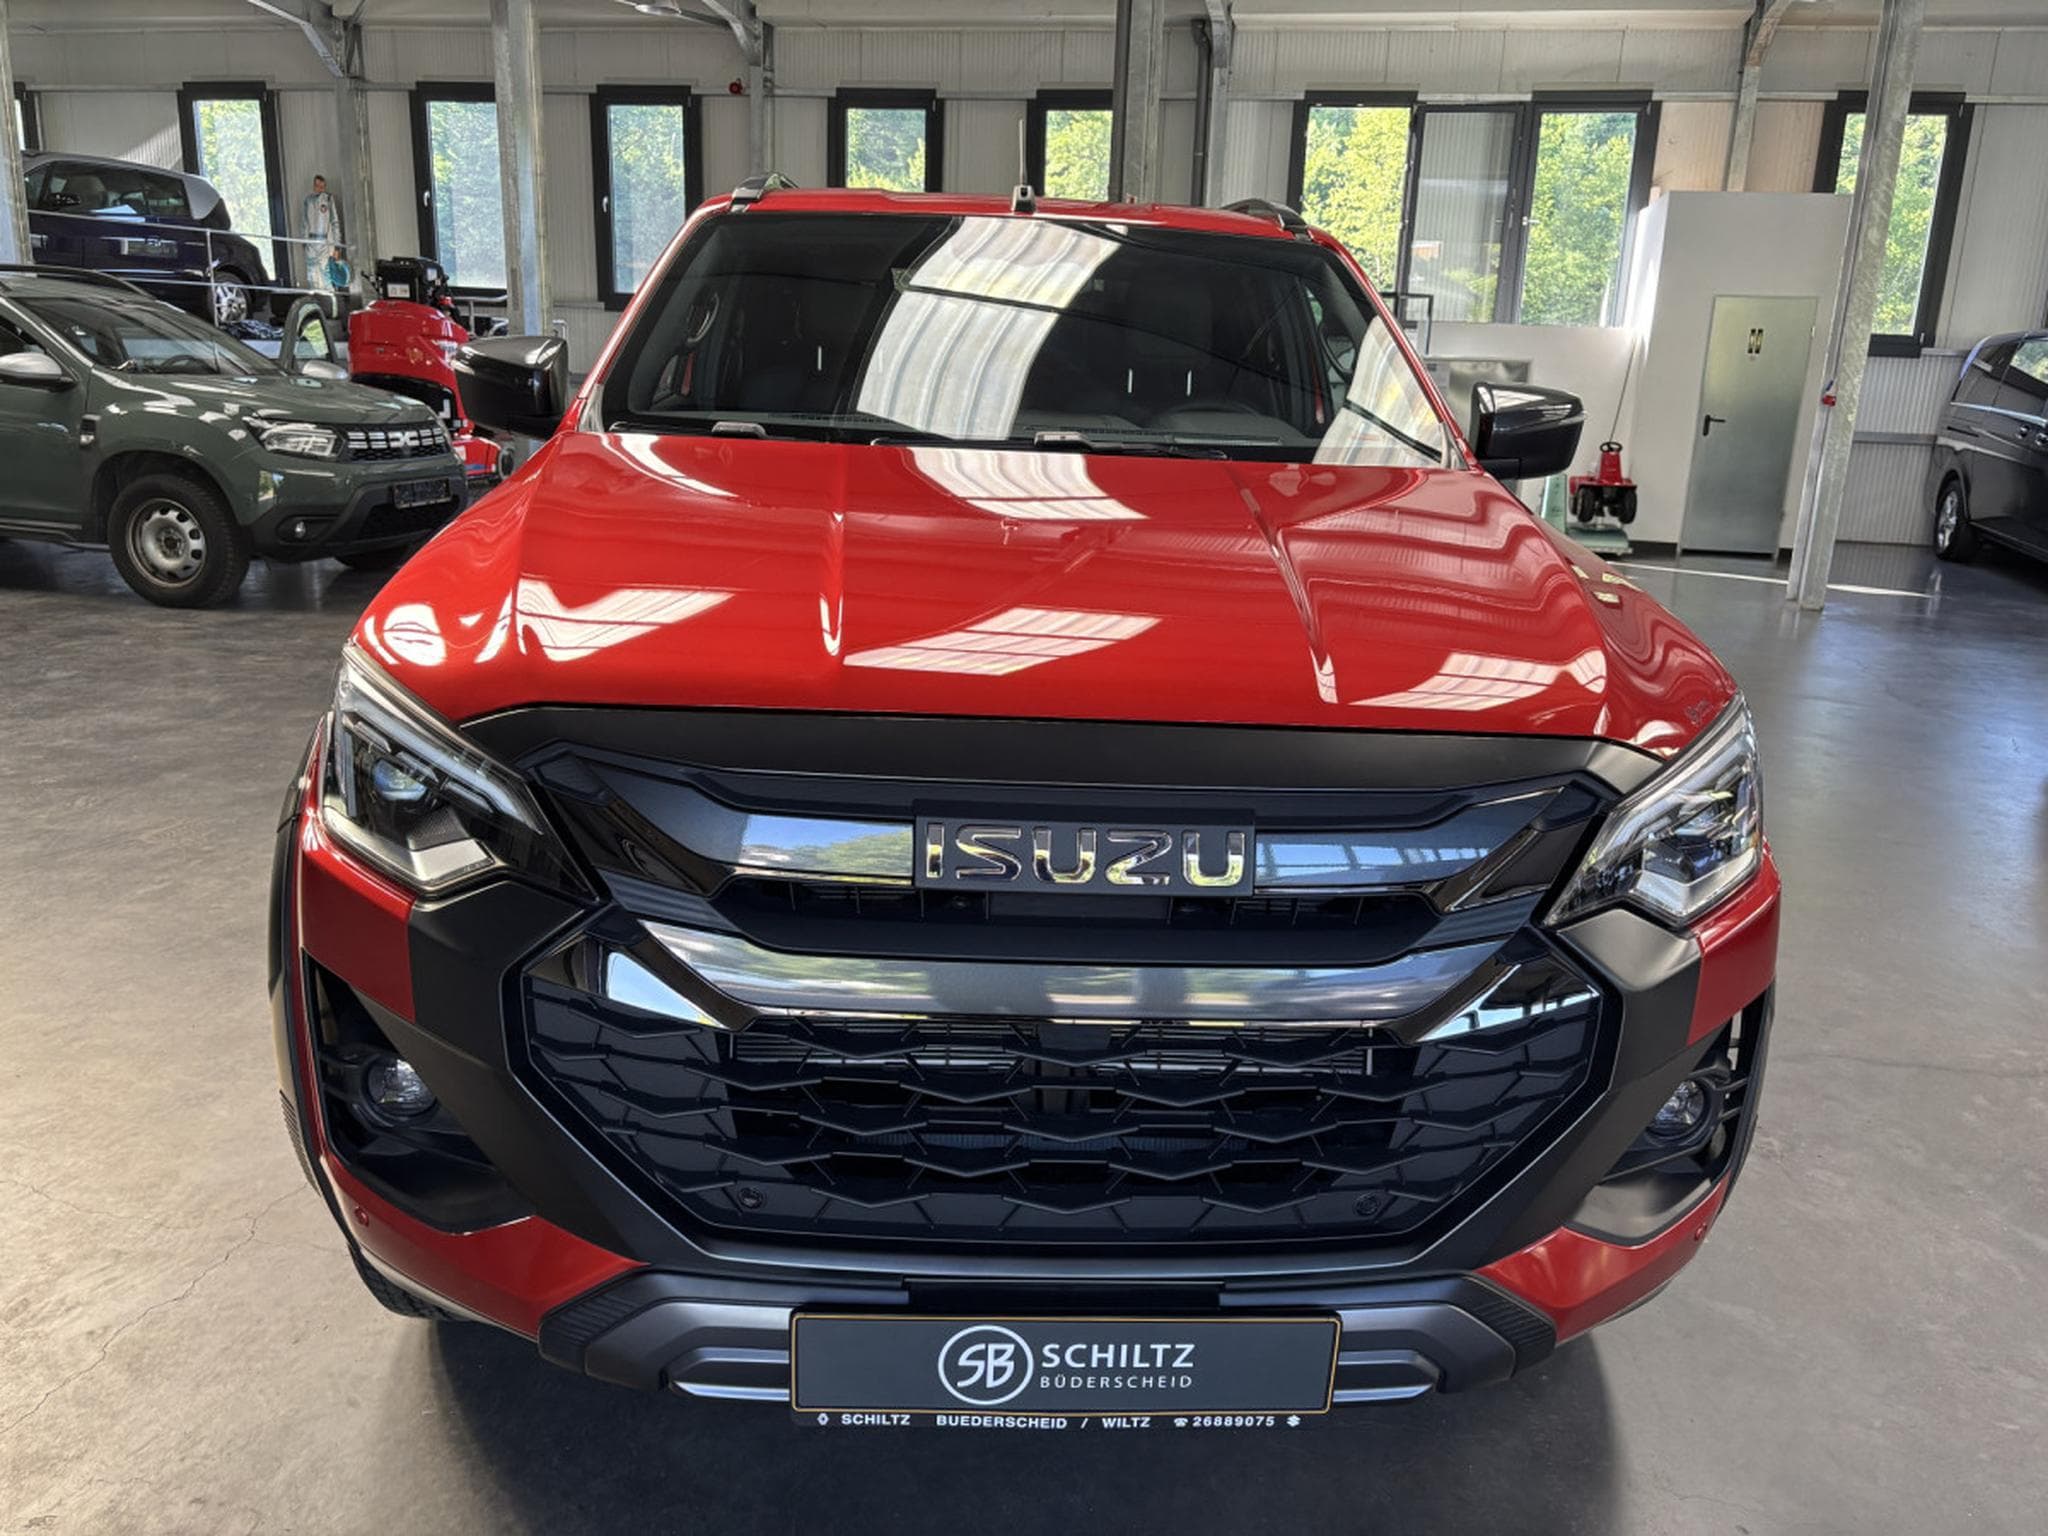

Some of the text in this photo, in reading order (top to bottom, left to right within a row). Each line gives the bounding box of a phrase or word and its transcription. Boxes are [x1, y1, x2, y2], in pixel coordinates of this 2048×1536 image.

[926, 822, 1246, 888] ISUZU
[1041, 1343, 1196, 1369] SCHILTZ
[1040, 1373, 1193, 1389] BÜDERSCHEID
[841, 1413, 911, 1426] SCHILTZ
[936, 1414, 1068, 1429] BUEDERSCHEID
[1101, 1416, 1151, 1429] WILTZ
[1192, 1415, 1275, 1428] 26889075
